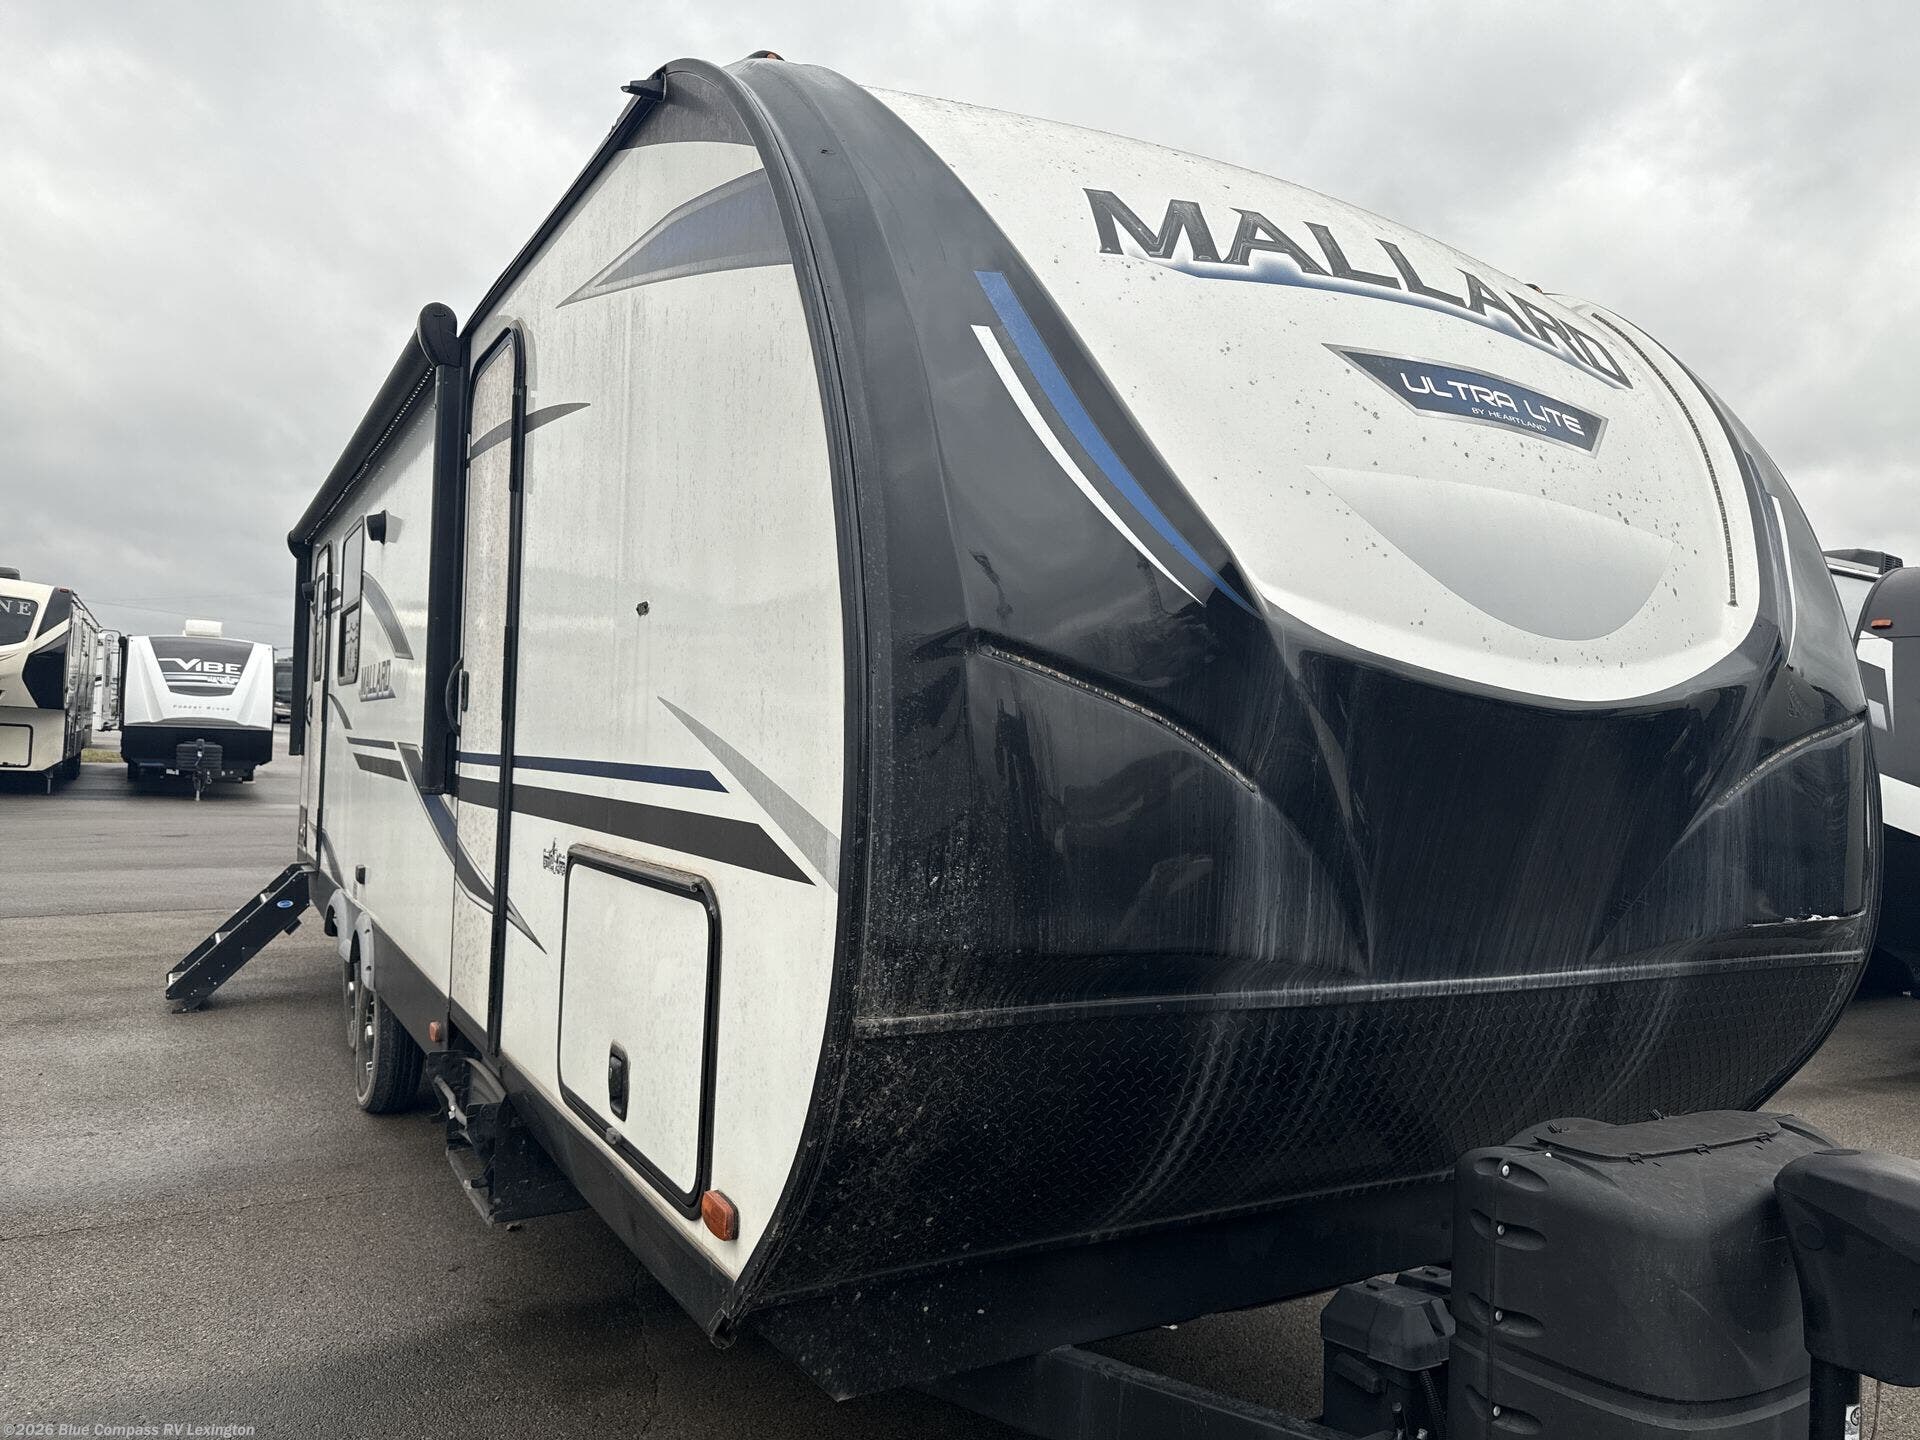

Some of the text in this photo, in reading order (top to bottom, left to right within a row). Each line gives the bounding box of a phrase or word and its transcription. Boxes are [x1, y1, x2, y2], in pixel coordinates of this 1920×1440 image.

[1083, 187, 1633, 390] MALLARD
[1400, 372, 1585, 436] ULTRA LITE
[1471, 406, 1547, 432] BY HEARTLAND
[158, 658, 242, 674] VIBE
